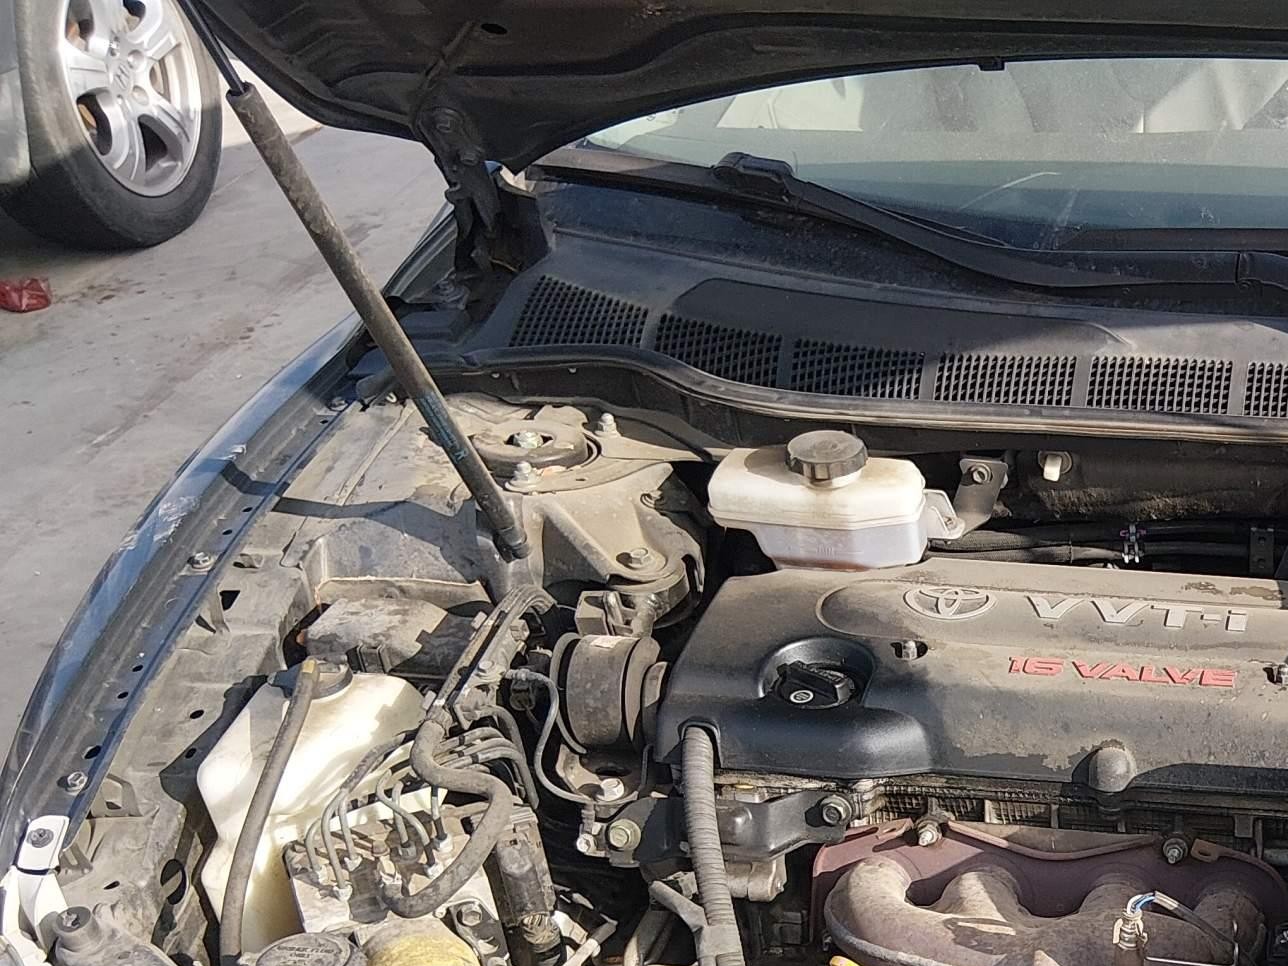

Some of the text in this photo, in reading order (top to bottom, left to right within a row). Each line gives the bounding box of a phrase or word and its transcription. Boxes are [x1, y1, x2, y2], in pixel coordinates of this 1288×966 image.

[1027, 594, 1248, 632] VVT-i
[1008, 657, 1238, 688] 16 VALVE
